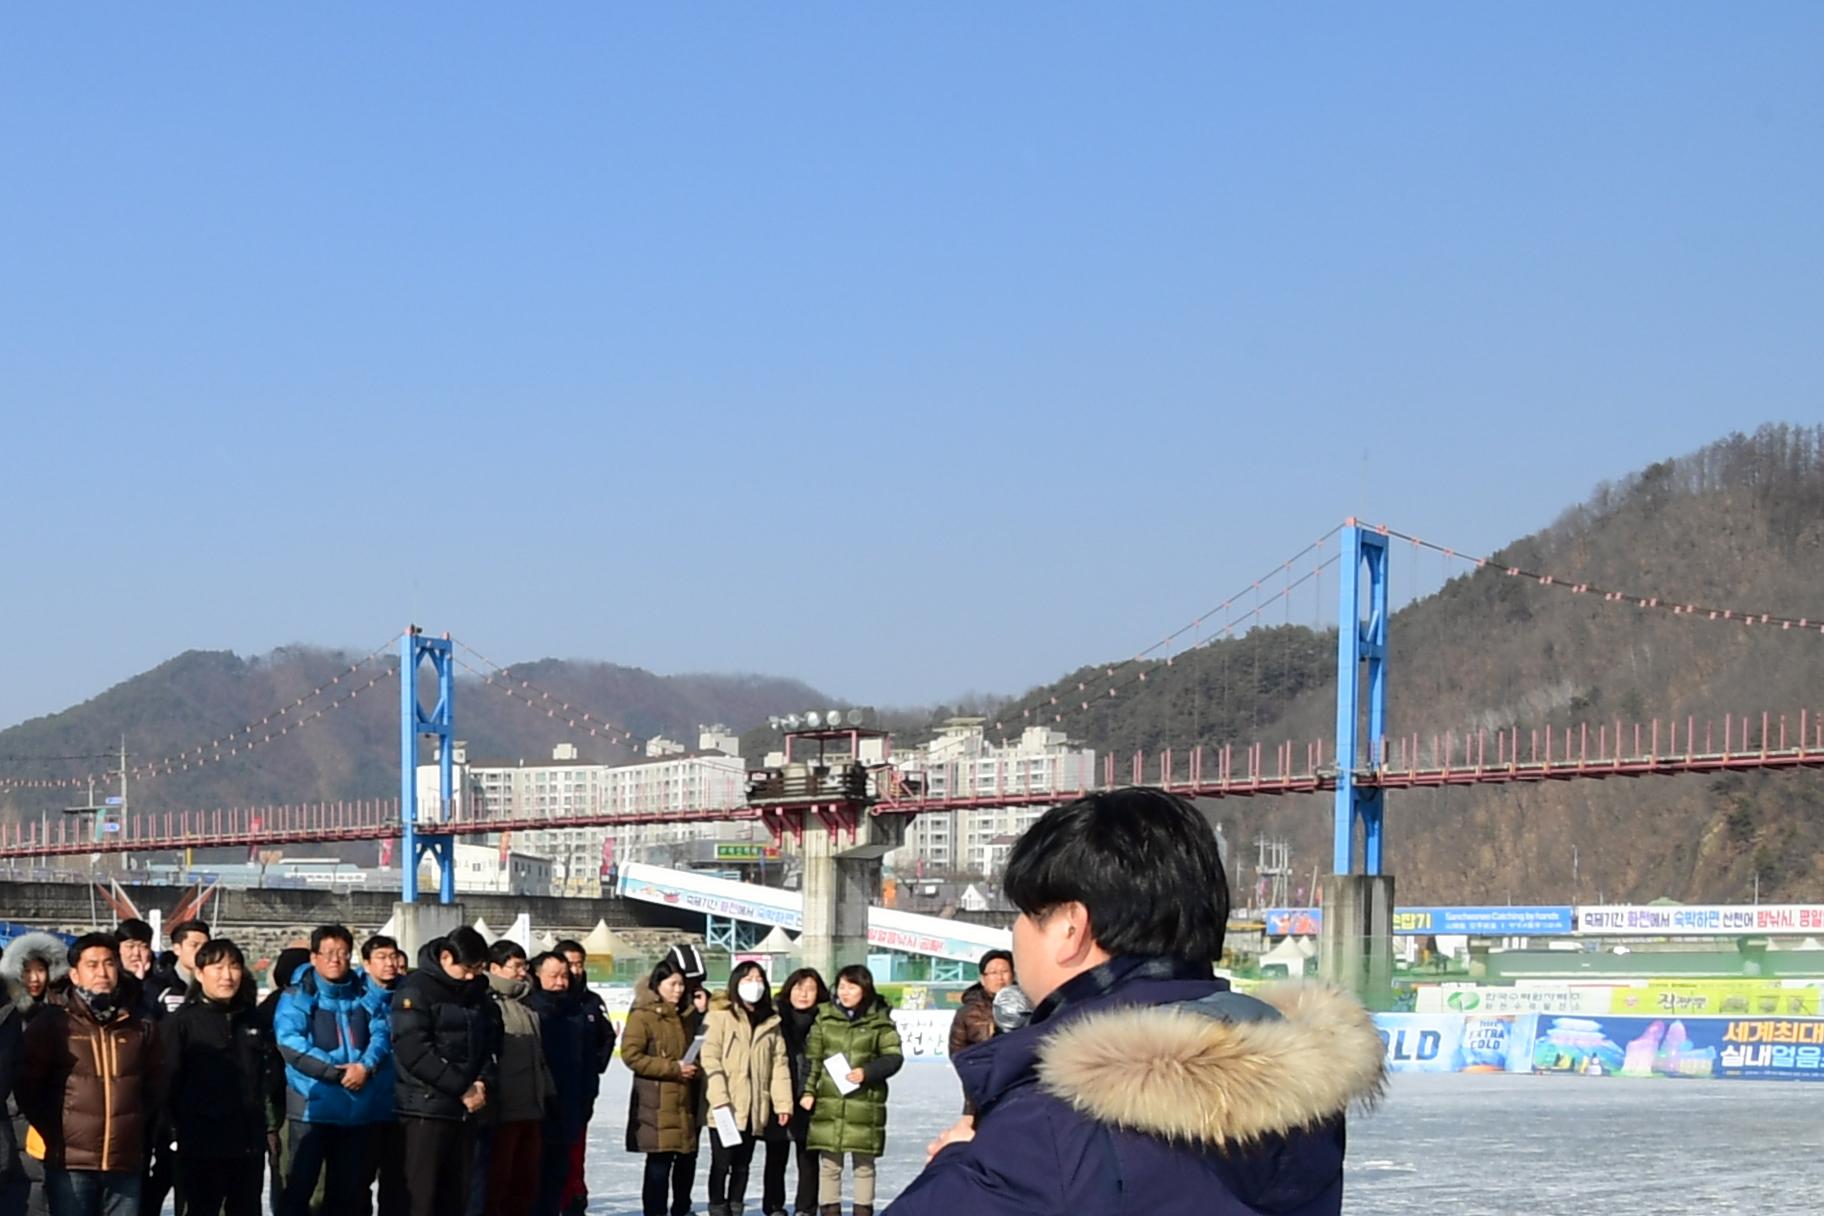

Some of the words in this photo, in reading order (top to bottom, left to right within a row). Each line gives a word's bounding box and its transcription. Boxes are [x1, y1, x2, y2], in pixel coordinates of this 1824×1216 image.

[1584, 913, 1623, 928] 축제기간
[1627, 911, 1670, 929] 화천에서
[1674, 910, 1720, 929] 숙박하면
[1723, 912, 1754, 928] 산천어
[1722, 1021, 1824, 1043] 세계최대
